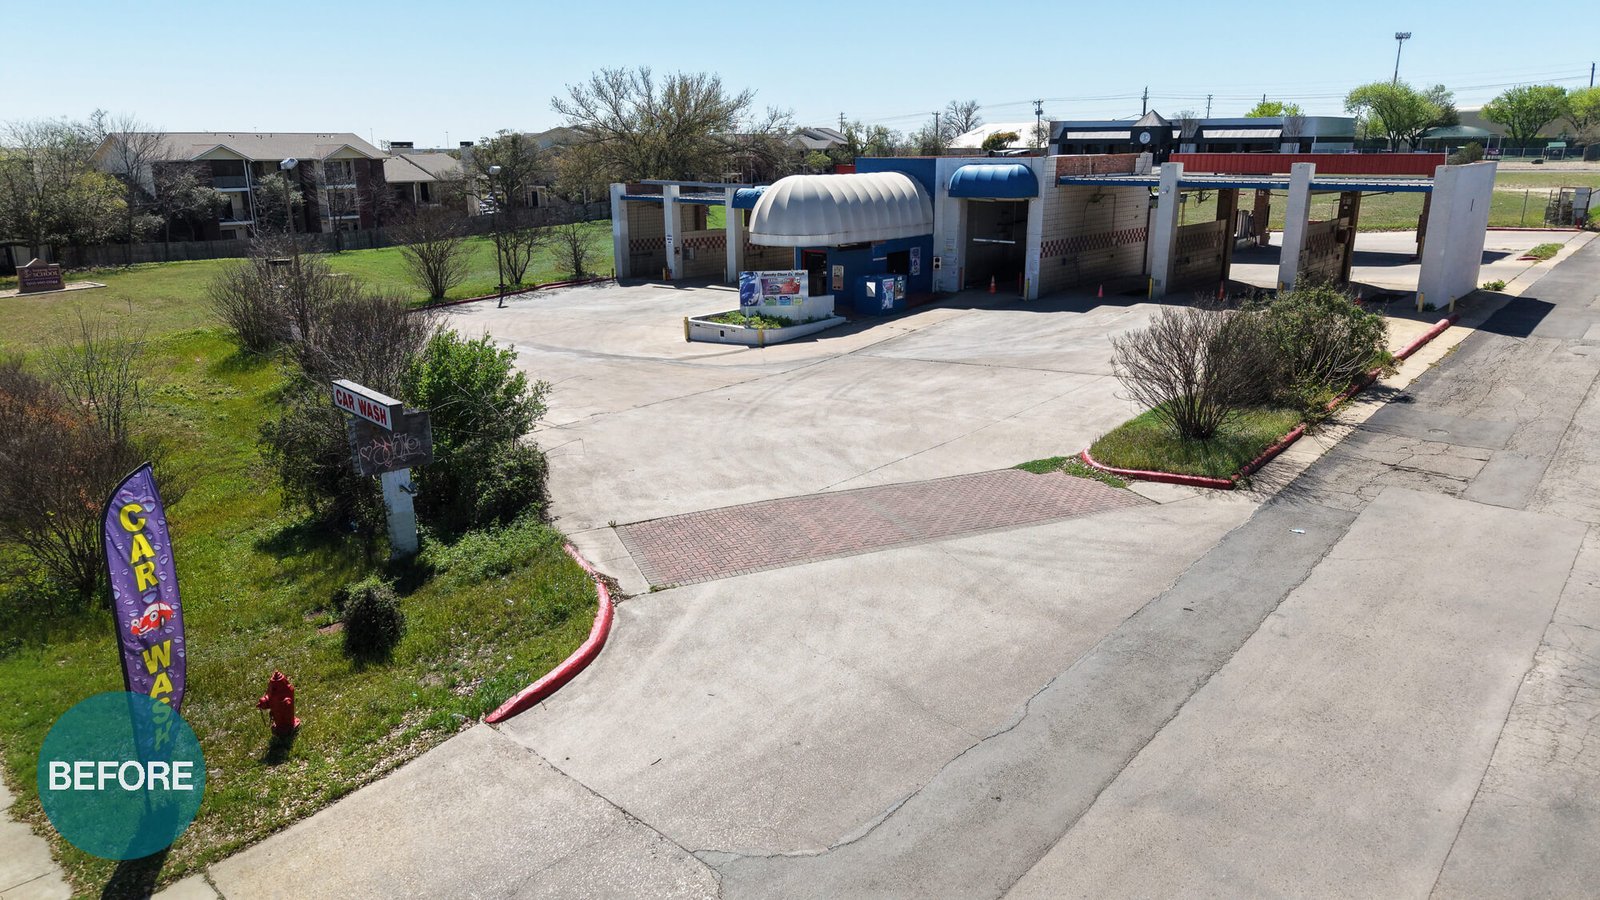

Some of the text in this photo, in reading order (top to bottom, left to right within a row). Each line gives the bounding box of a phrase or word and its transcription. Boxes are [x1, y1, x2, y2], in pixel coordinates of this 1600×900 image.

[336, 389, 387, 425] CAR WASH
[120, 503, 173, 752] CAR WASH
